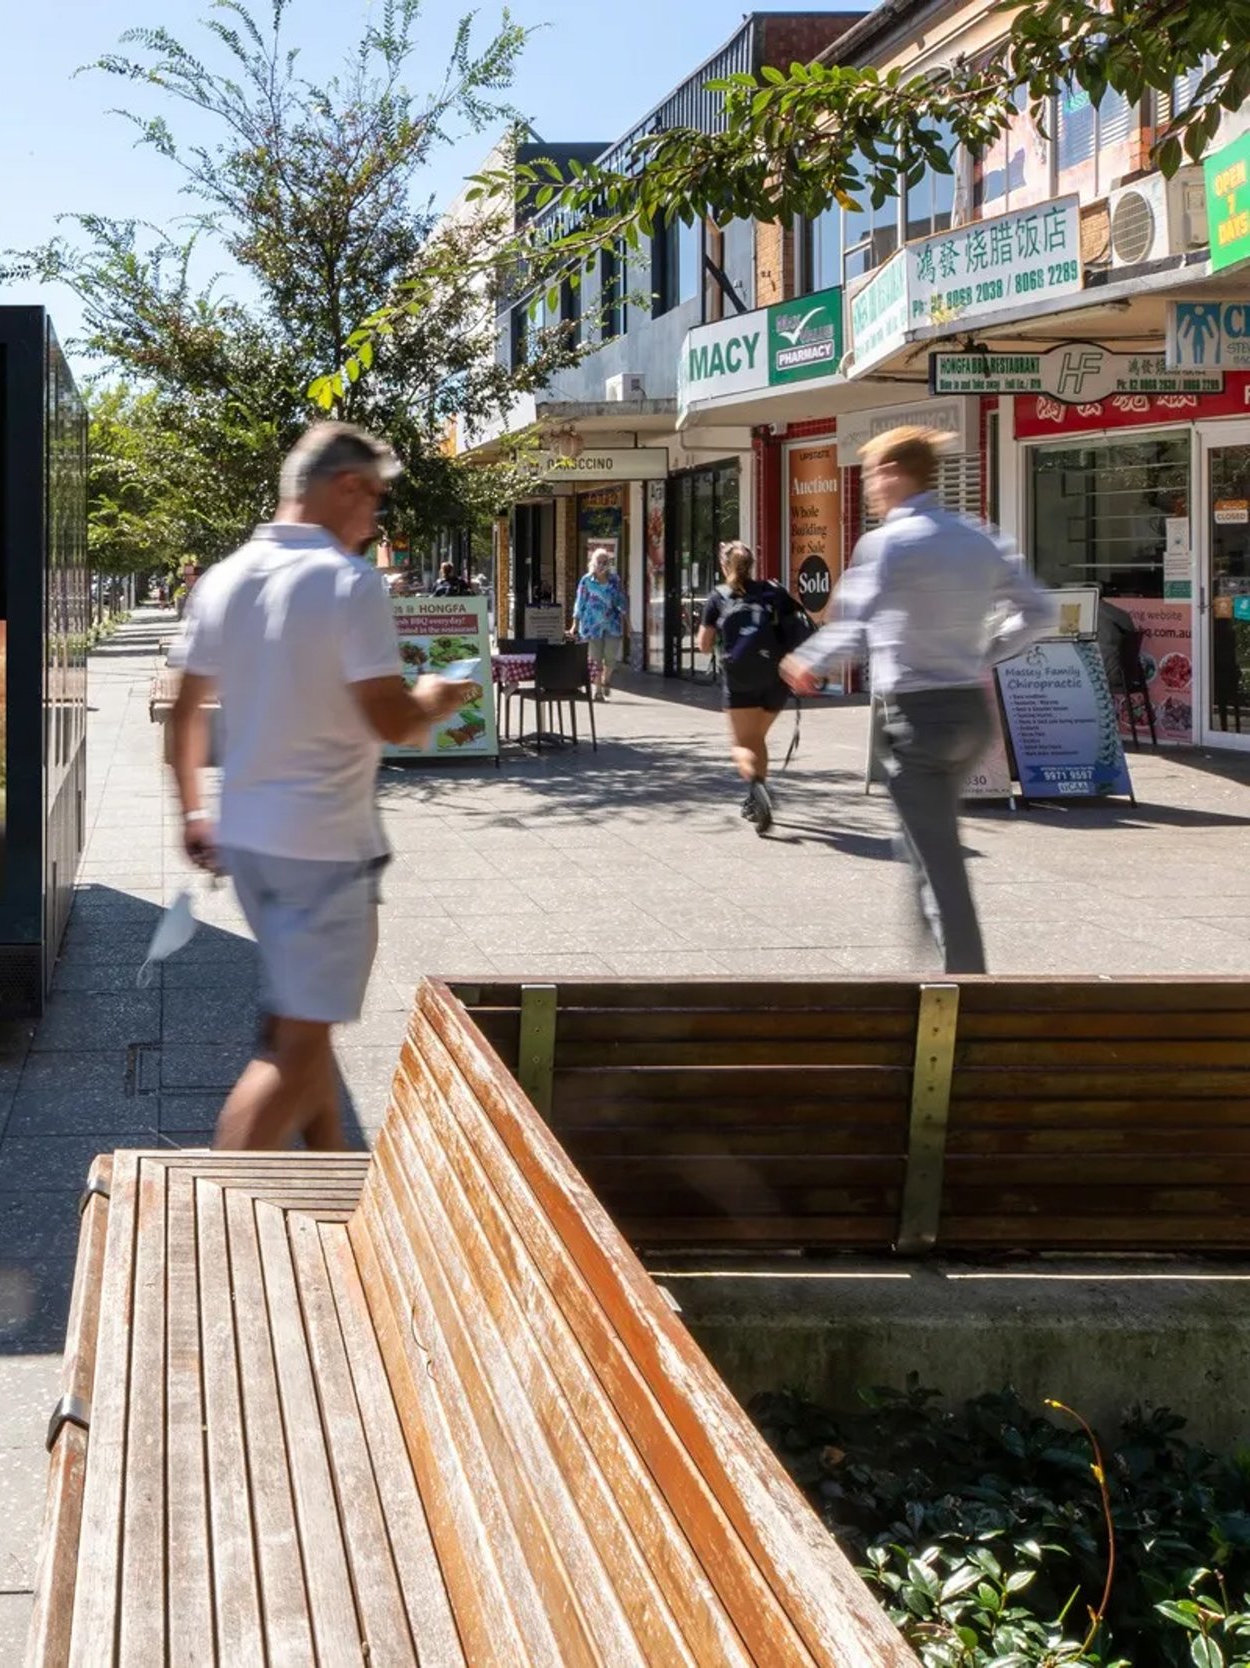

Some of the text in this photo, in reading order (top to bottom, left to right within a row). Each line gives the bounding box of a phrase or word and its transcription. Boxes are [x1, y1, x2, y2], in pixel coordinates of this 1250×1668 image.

[1215, 160, 1247, 196] OPEN
[1227, 192, 1236, 215] 7
[1218, 210, 1249, 246] DAYS
[976, 279, 1004, 303] 2038
[1015, 268, 1045, 294] 8068
[1048, 259, 1078, 286] 2289
[778, 342, 832, 367] PHARMACY
[940, 357, 971, 374] HONGFA
[990, 356, 1040, 374] RESTAURANT
[799, 449, 830, 461] UPSTATE
[791, 475, 838, 496] Auction
[791, 505, 820, 518] Whole
[1216, 511, 1246, 521] CLOSED
[791, 522, 827, 539] Building
[791, 540, 826, 554] For Sale
[798, 571, 829, 594] Sold
[418, 603, 467, 614] HONGFA
[1147, 608, 1183, 621] website
[1138, 625, 1192, 639] bq.com.au
[1005, 666, 1080, 678] Massey Family
[1007, 679, 1083, 692] Chiropractic
